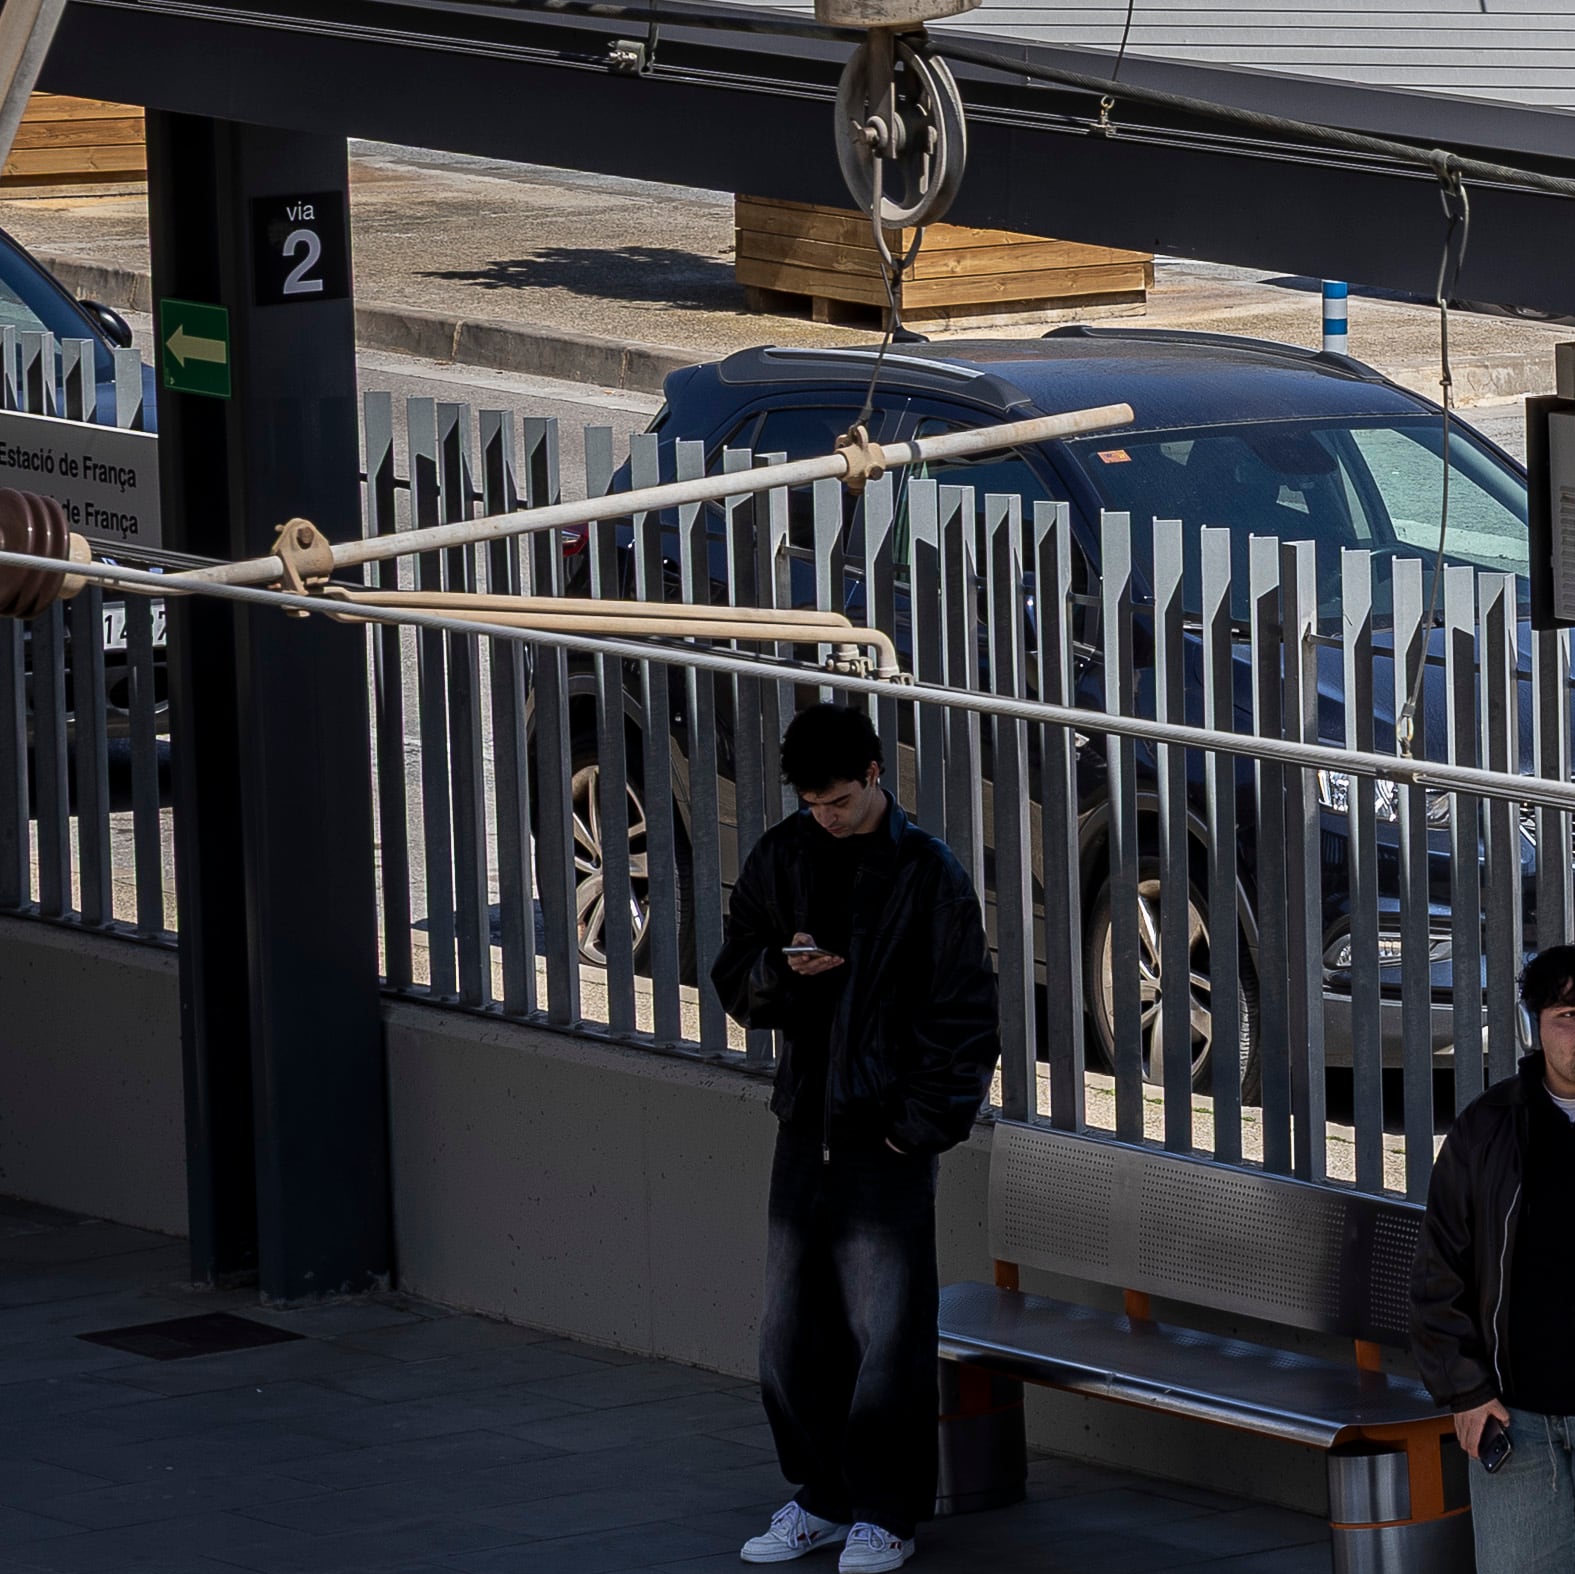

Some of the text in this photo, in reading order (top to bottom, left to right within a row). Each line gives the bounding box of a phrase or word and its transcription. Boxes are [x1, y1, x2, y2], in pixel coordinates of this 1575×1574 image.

[286, 201, 315, 221] via
[282, 229, 323, 294] 2
[59, 453, 78, 478] de
[83, 456, 137, 493] França
[85, 503, 138, 539] França
